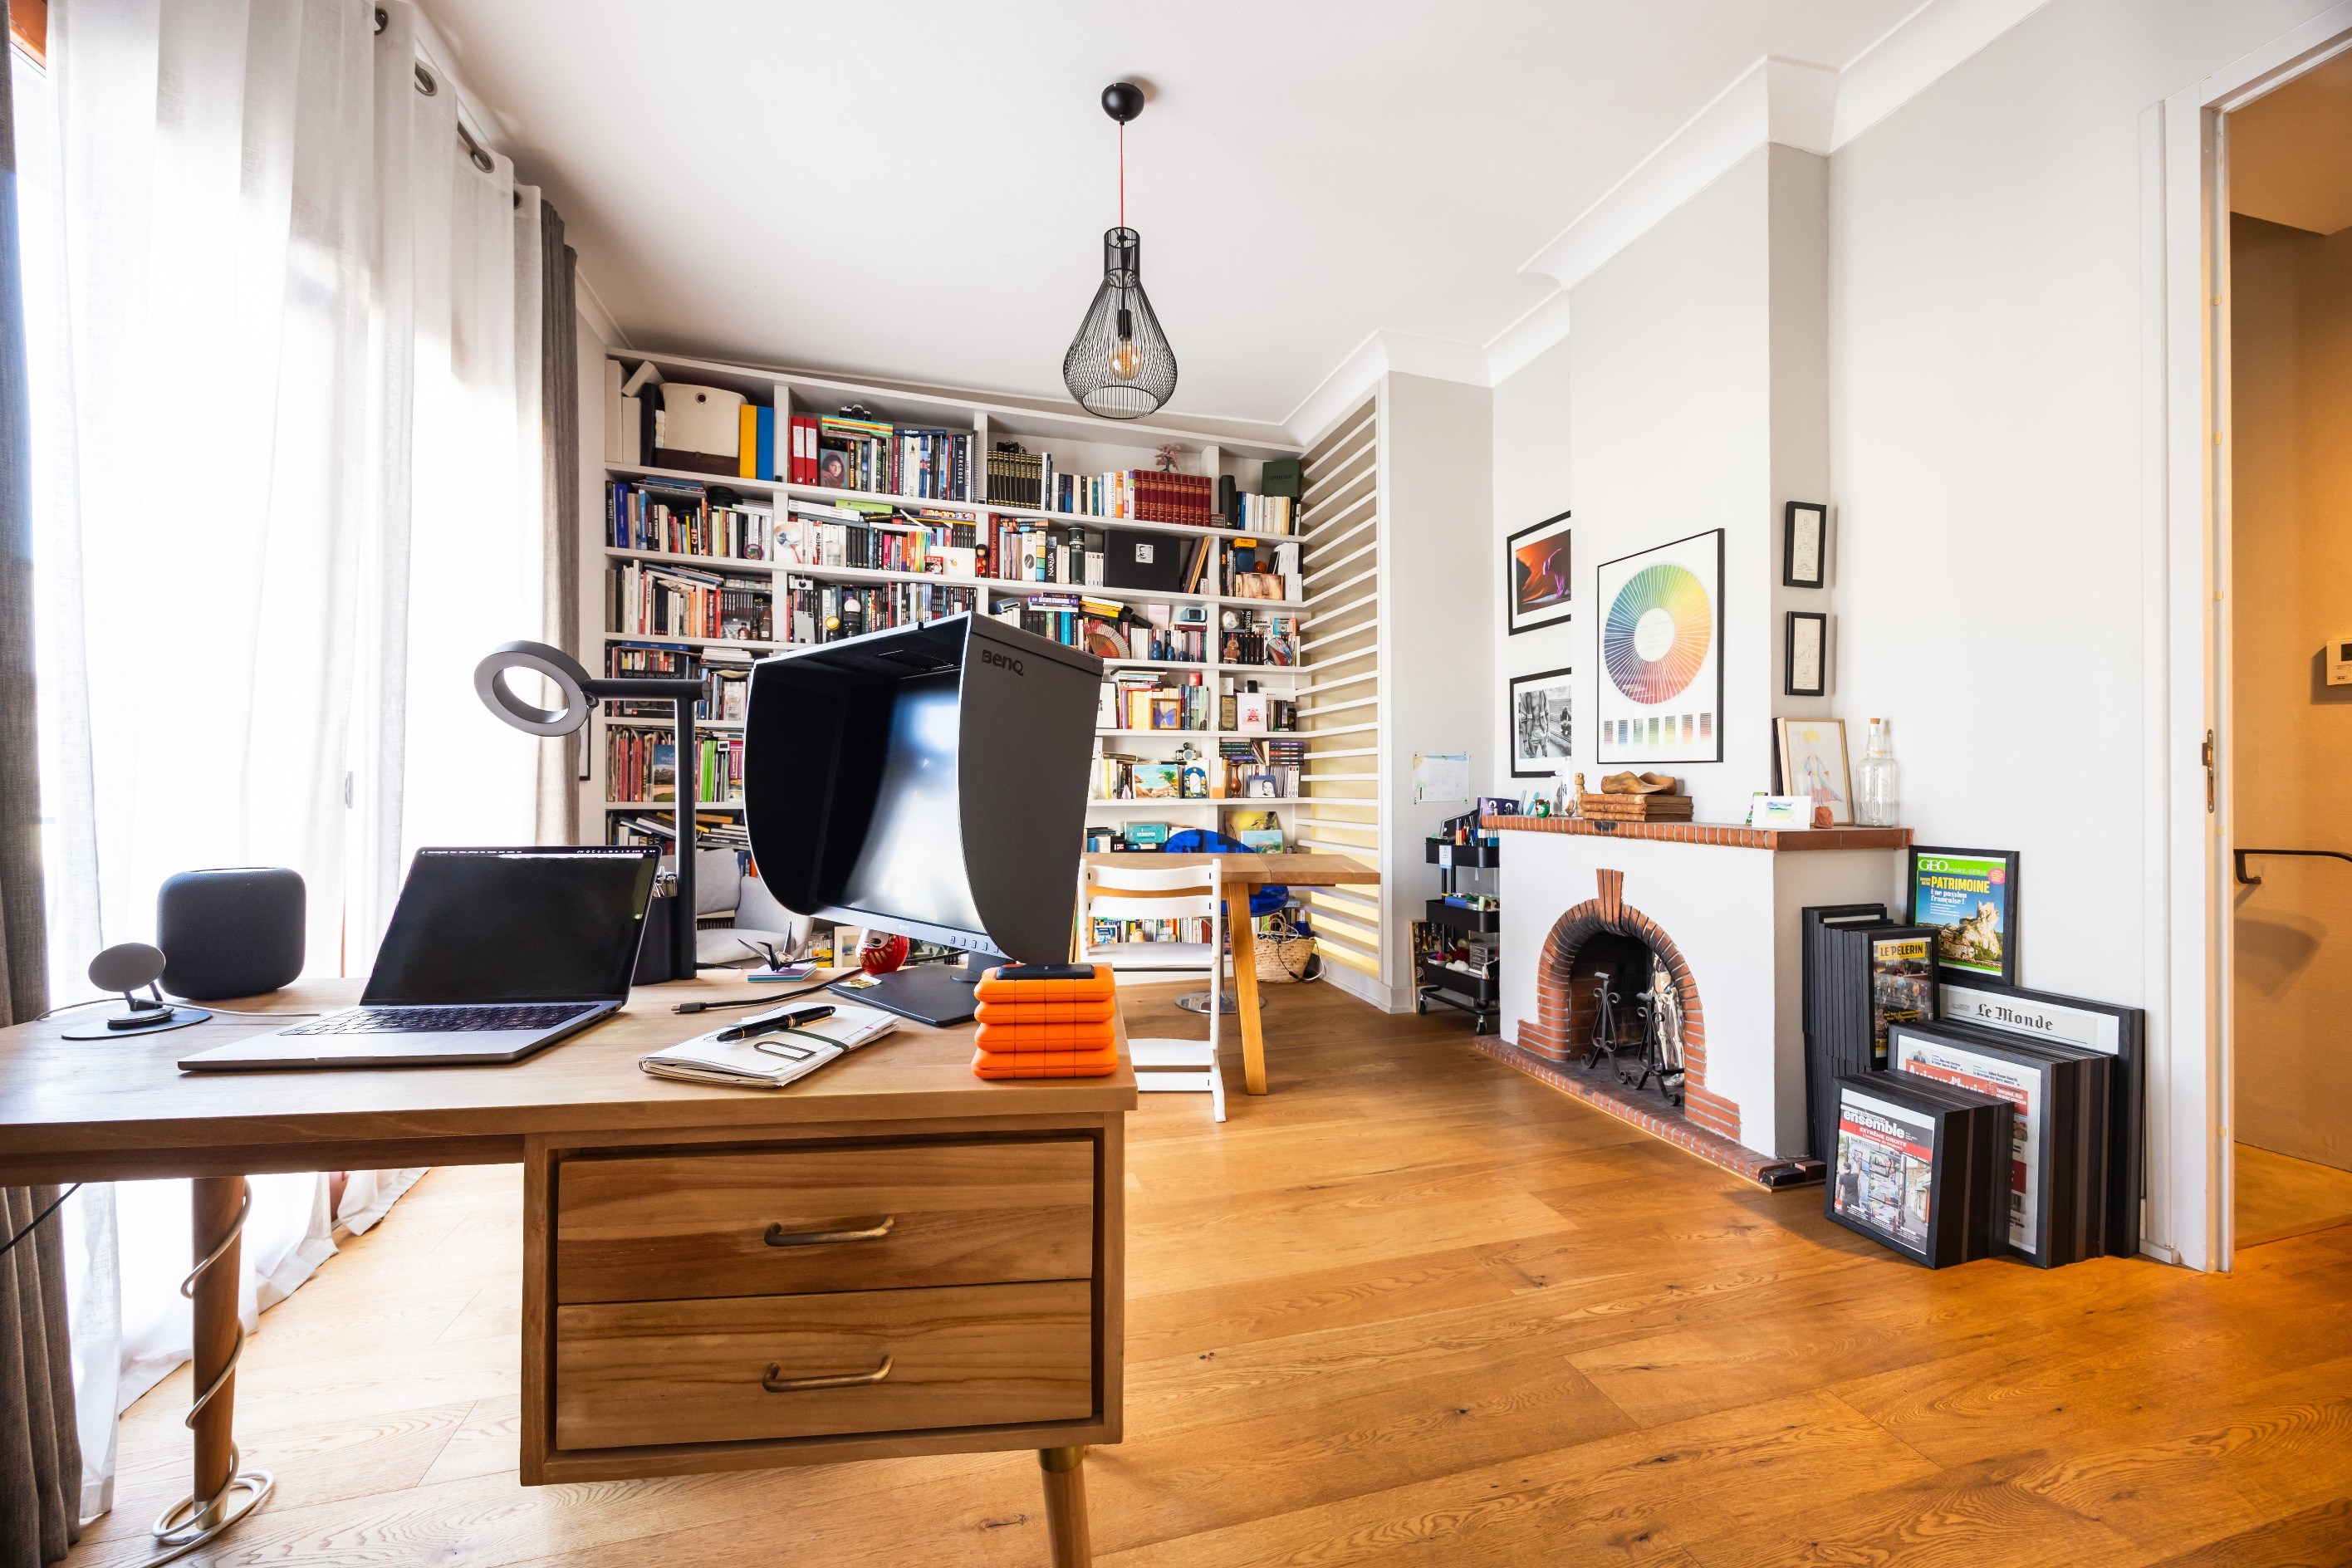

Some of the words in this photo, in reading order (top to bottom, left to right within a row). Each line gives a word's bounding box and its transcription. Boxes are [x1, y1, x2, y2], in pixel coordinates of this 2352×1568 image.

[982, 649, 1024, 677] BenQ
[1918, 859, 1948, 872] GEO
[1931, 875, 1991, 894] PATRIMOINE
[1931, 895, 1962, 904] française
[1943, 890, 1967, 899] passion
[1880, 947, 1889, 957] LE
[1976, 1003, 1992, 1017] Le
[1993, 1006, 2053, 1031] Monde
[1843, 1110, 1905, 1139] ensemble
[1860, 1127, 1885, 1139] EXTRÊME
[1885, 1136, 1907, 1148] DROITE
